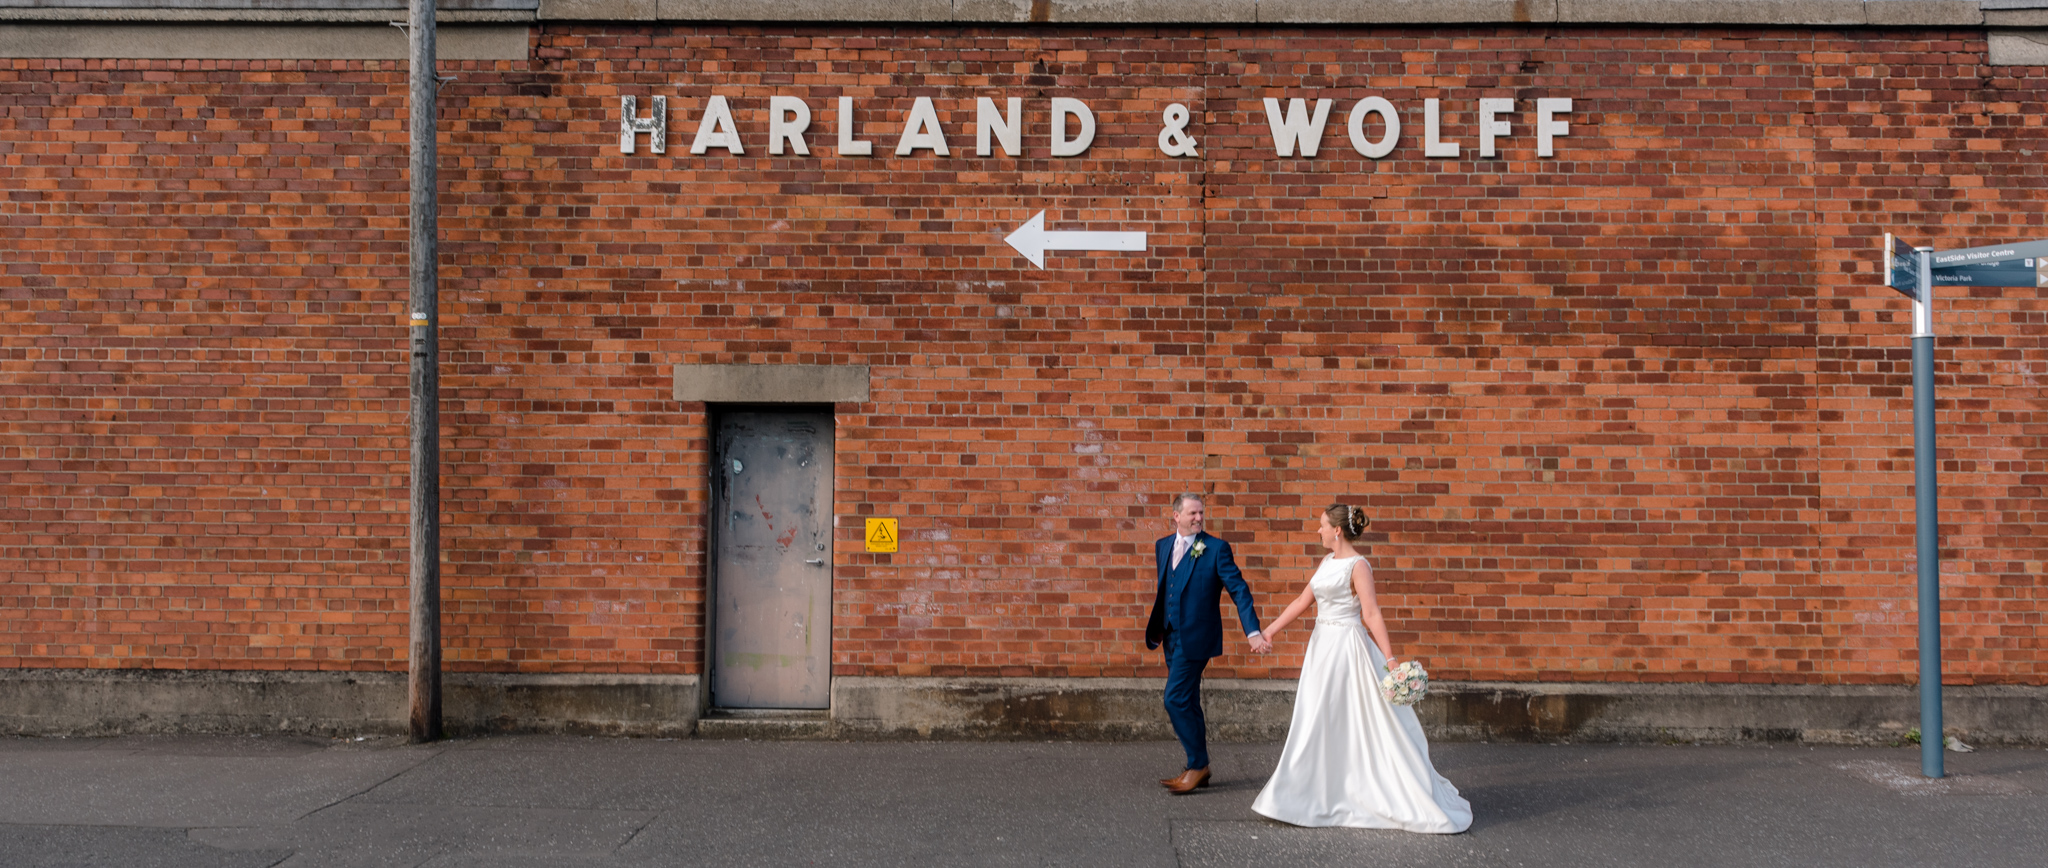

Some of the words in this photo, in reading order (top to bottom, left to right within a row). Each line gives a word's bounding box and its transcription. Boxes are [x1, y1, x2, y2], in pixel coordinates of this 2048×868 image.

[620, 95, 1096, 157] HARLAND
[1158, 103, 1199, 157] &
[1263, 96, 1573, 158] WOLFF
[1936, 254, 1966, 263] EastSide
[1966, 251, 1990, 260] Visitor
[1991, 249, 2015, 257] Centre
